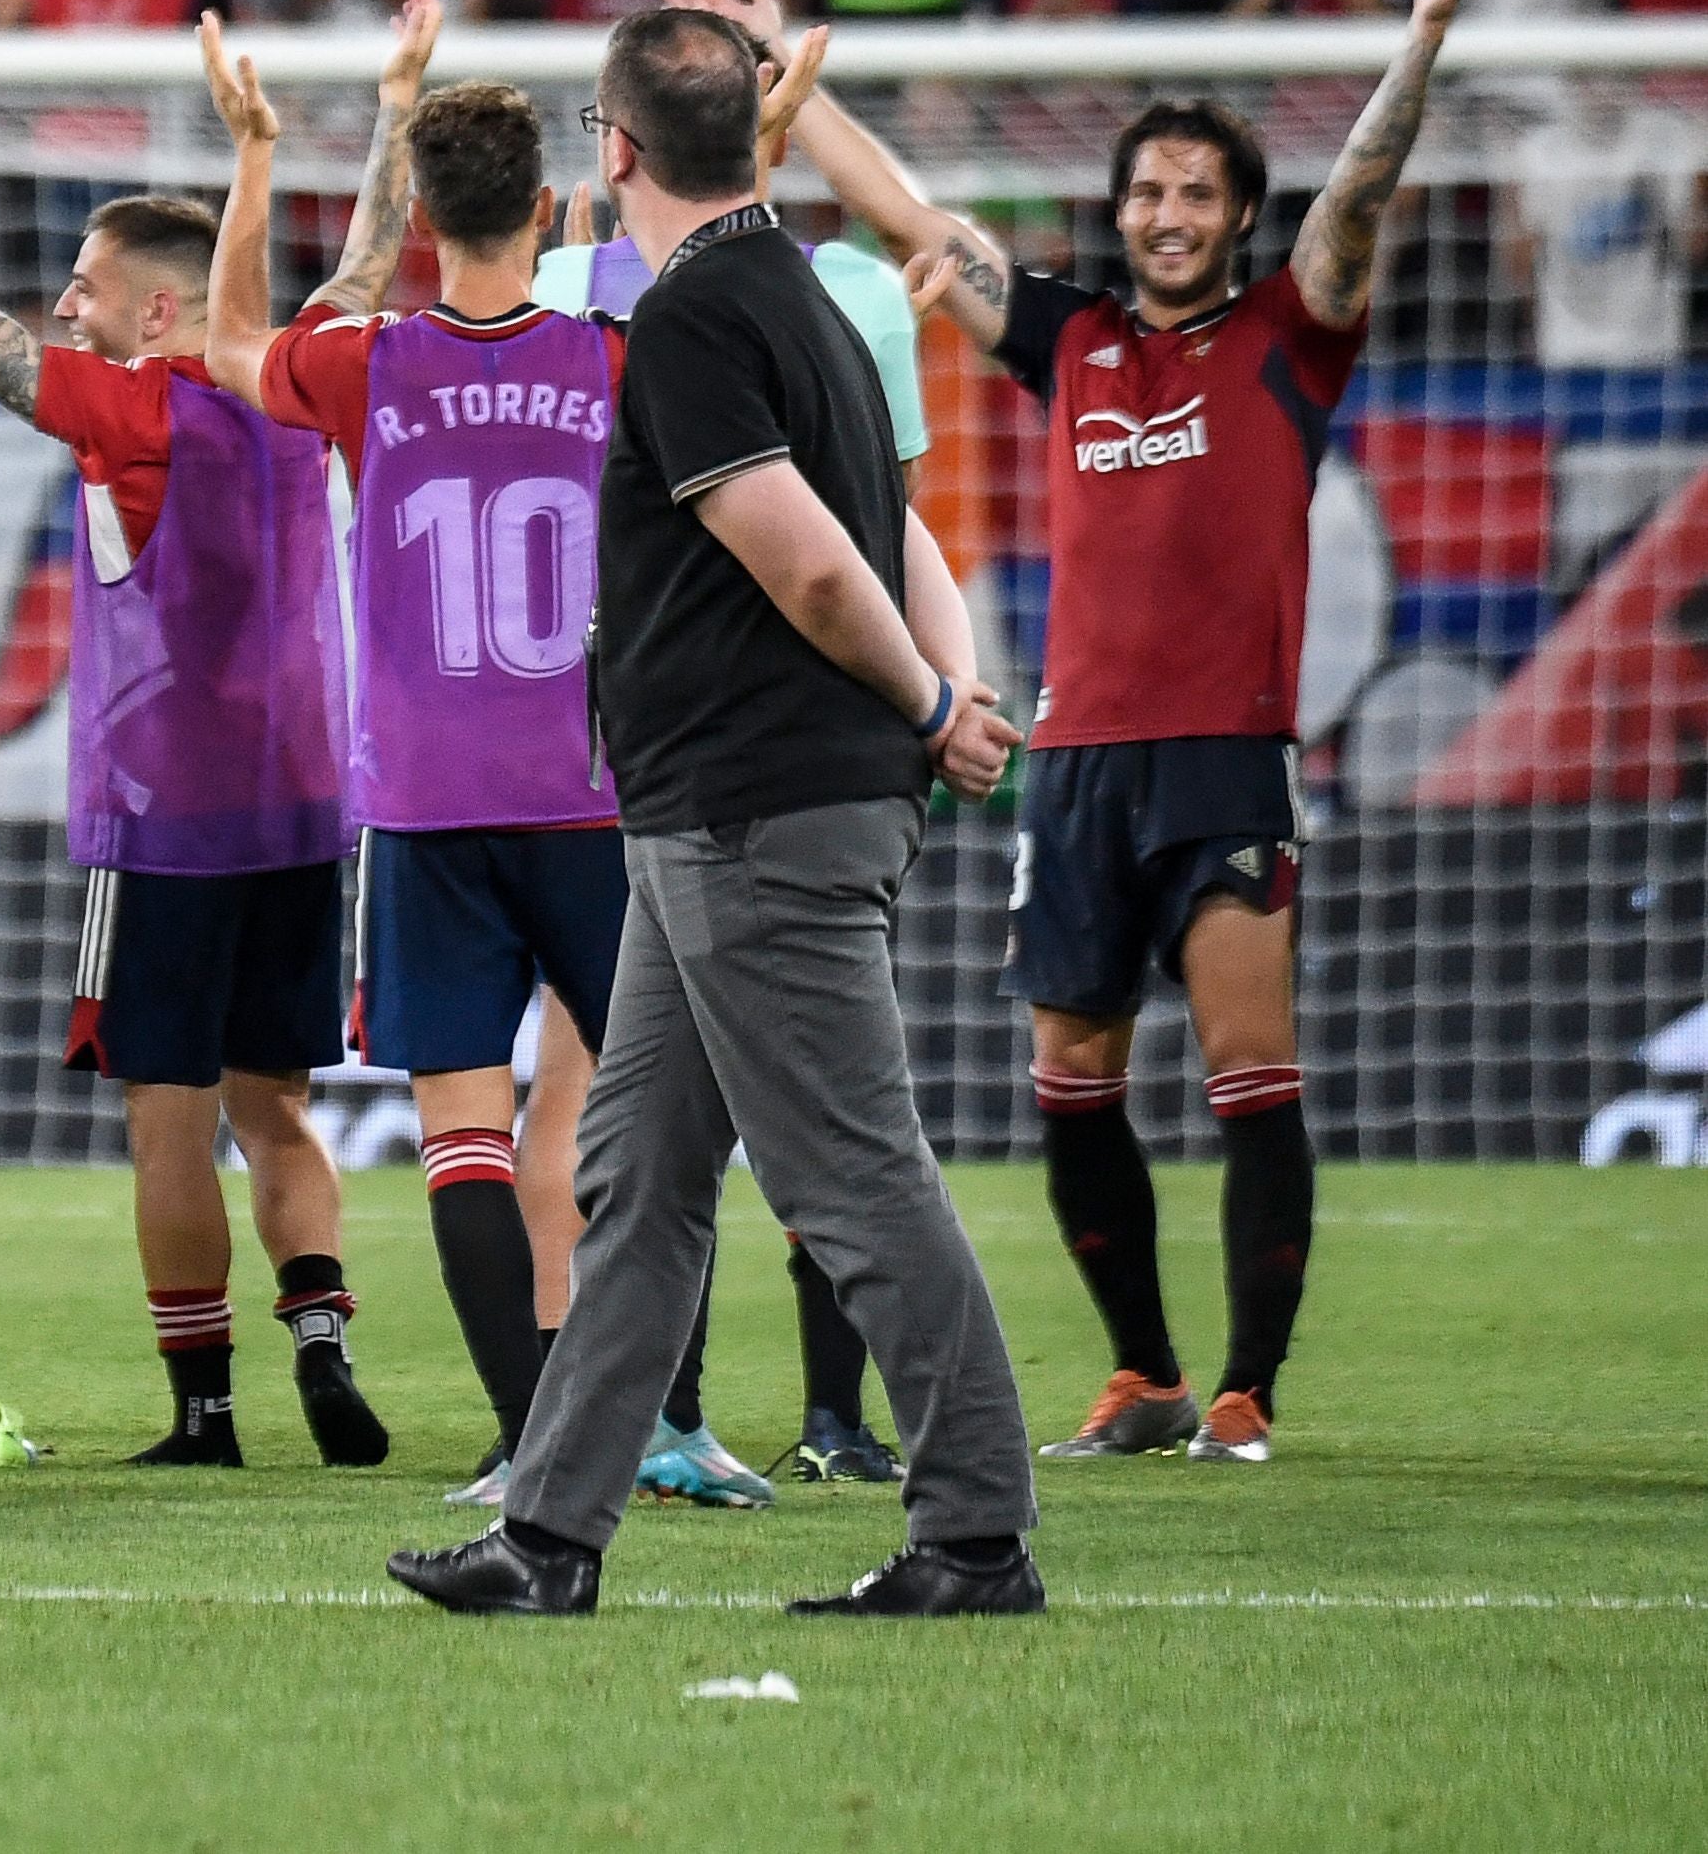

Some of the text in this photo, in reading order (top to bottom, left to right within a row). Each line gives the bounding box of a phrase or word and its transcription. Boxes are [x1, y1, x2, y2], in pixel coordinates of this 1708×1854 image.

[373, 383, 608, 451] R. TORRES
[393, 476, 596, 679] 10
